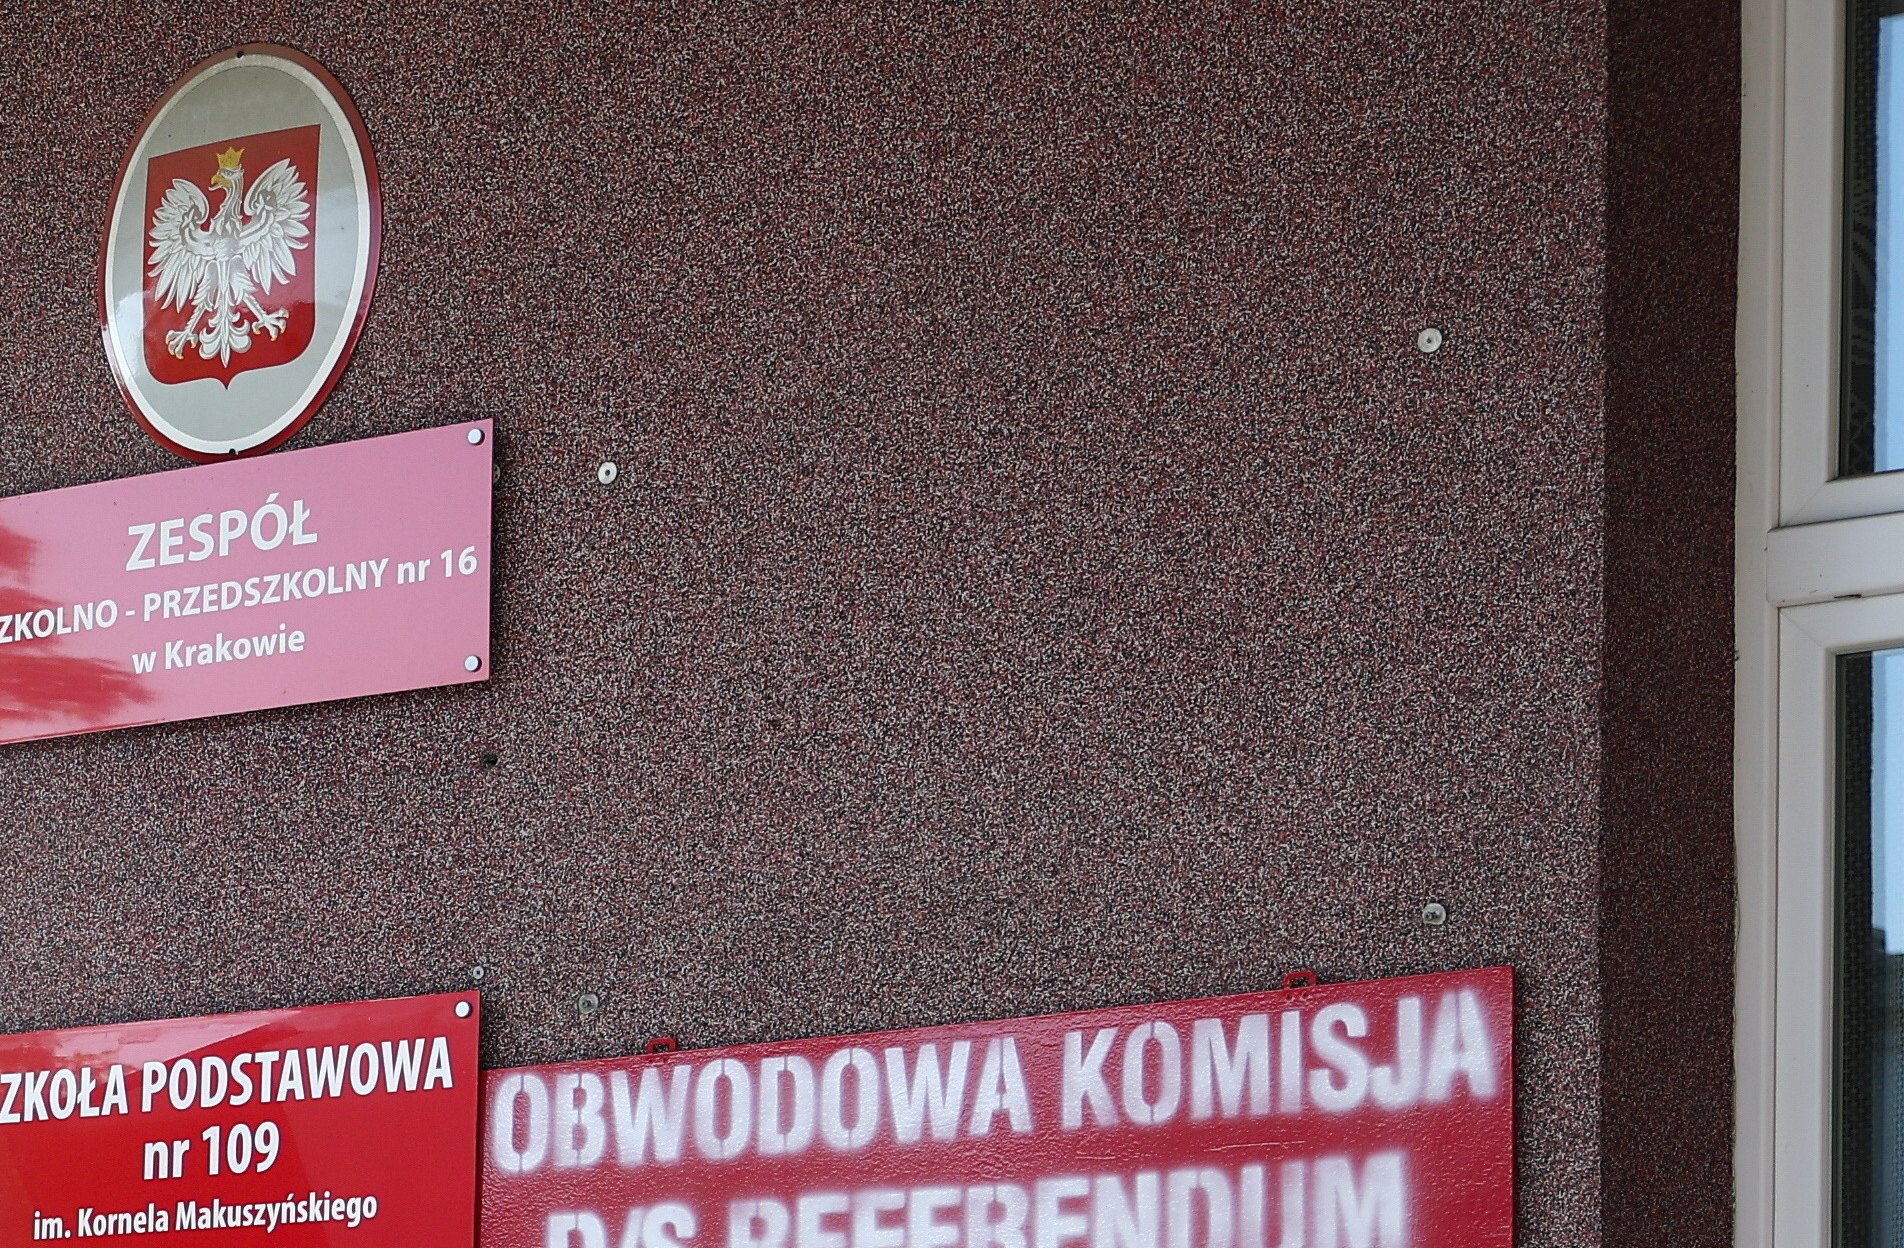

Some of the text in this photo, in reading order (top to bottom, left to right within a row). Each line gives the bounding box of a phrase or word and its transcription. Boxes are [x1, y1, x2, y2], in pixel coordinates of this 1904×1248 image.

[126, 492, 317, 571] ZESPÓŁ
[144, 557, 387, 622] PRZEDSZKOLNY
[397, 559, 430, 585] nr
[439, 546, 477, 578] 16
[133, 625, 305, 674] w Krakowie
[141, 1036, 453, 1112] PODSTAWOWA
[487, 986, 1501, 1178] OBWODOWA KOMISJA
[143, 1120, 280, 1180] nr 109
[33, 1191, 377, 1240] im. Kornela Makuszyńskiego
